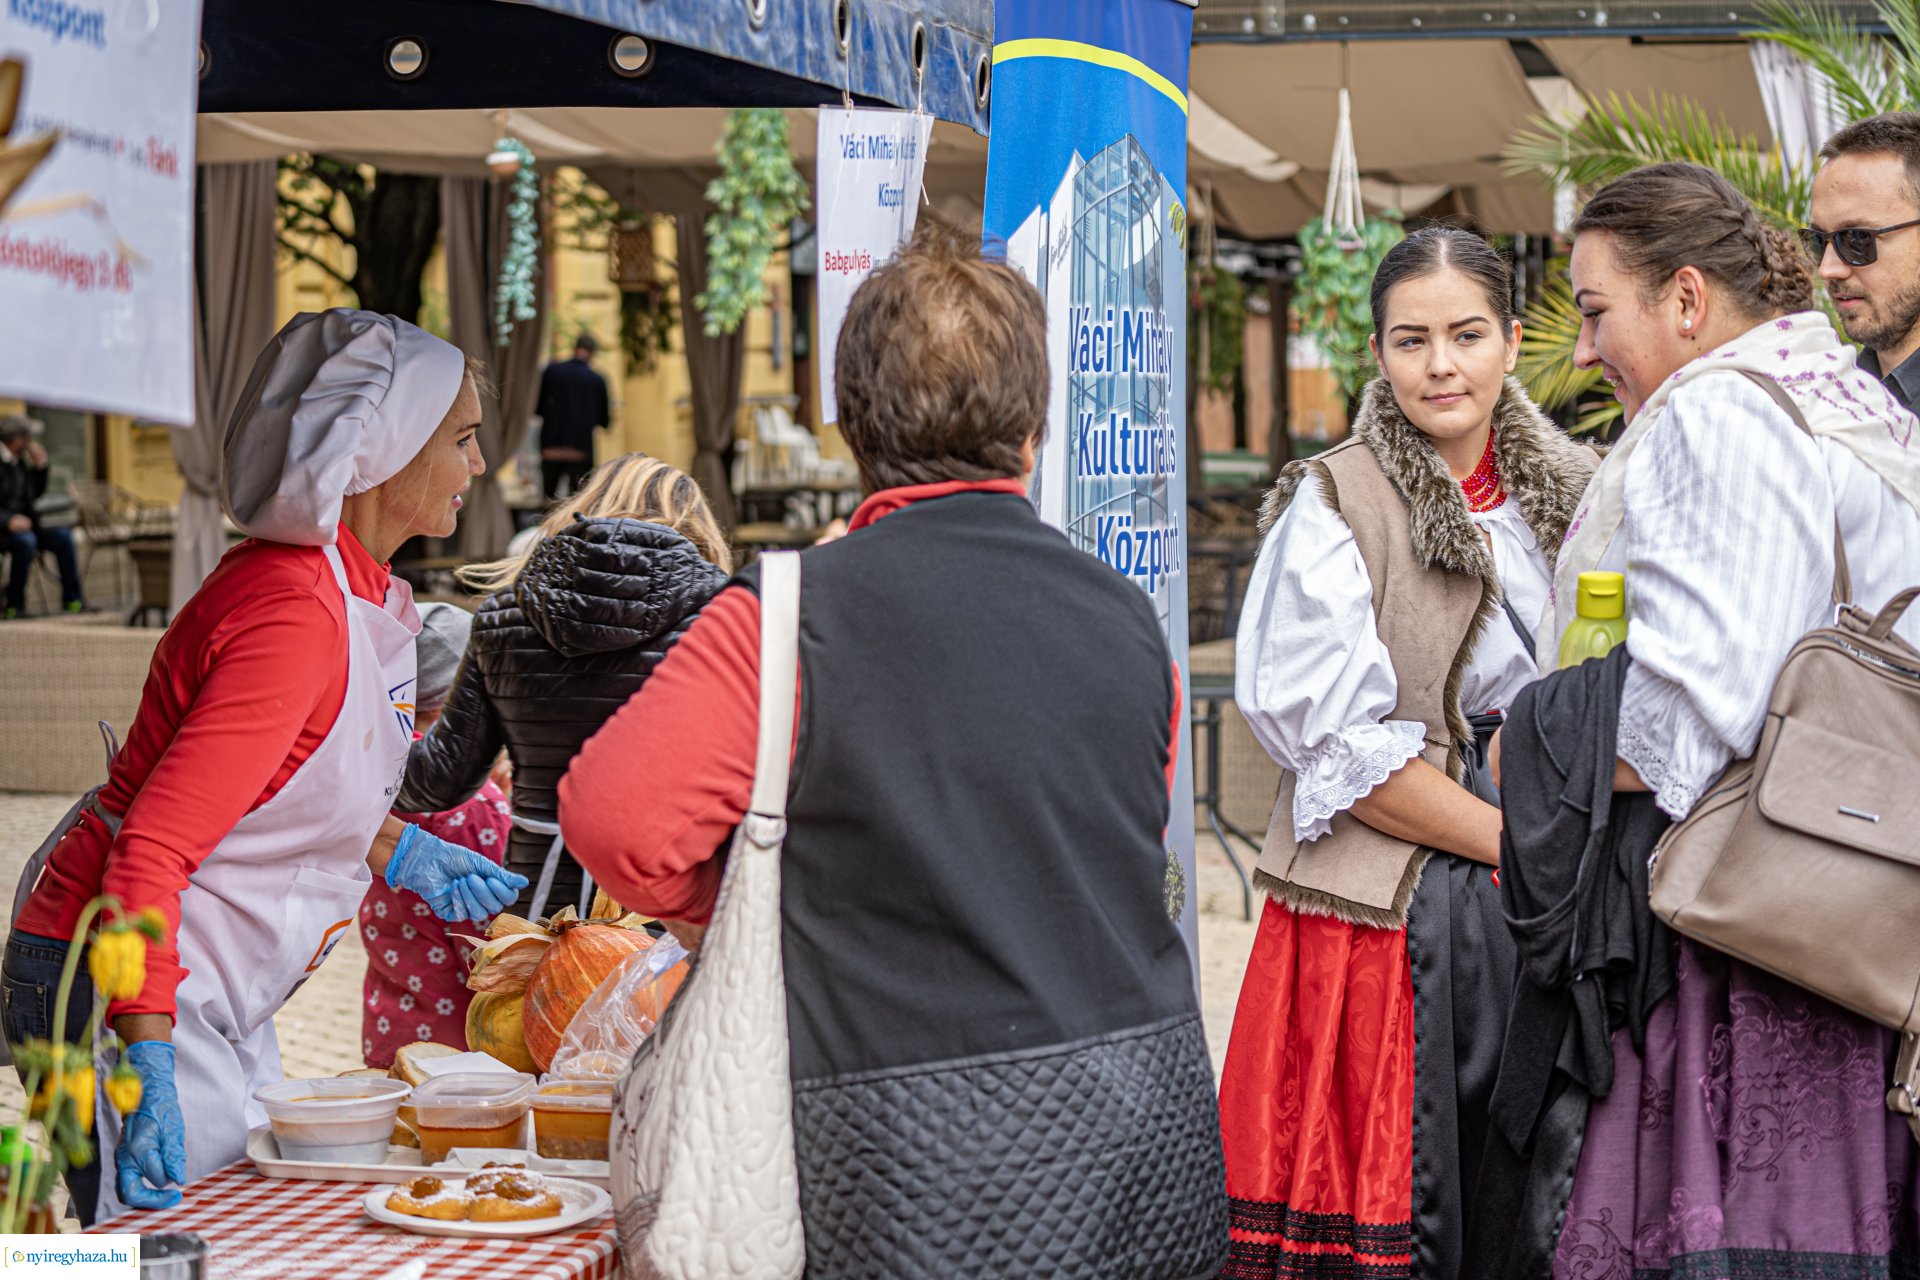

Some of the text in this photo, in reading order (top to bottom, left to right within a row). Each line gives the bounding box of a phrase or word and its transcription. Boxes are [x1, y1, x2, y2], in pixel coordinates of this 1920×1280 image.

[841, 133, 865, 159] Váci
[868, 135, 900, 166] Mihály
[825, 250, 871, 275] Babgulyás
[1069, 307, 1172, 393] Váci Mihály
[1078, 411, 1176, 477] Kulturális
[1097, 514, 1180, 593] Központ
